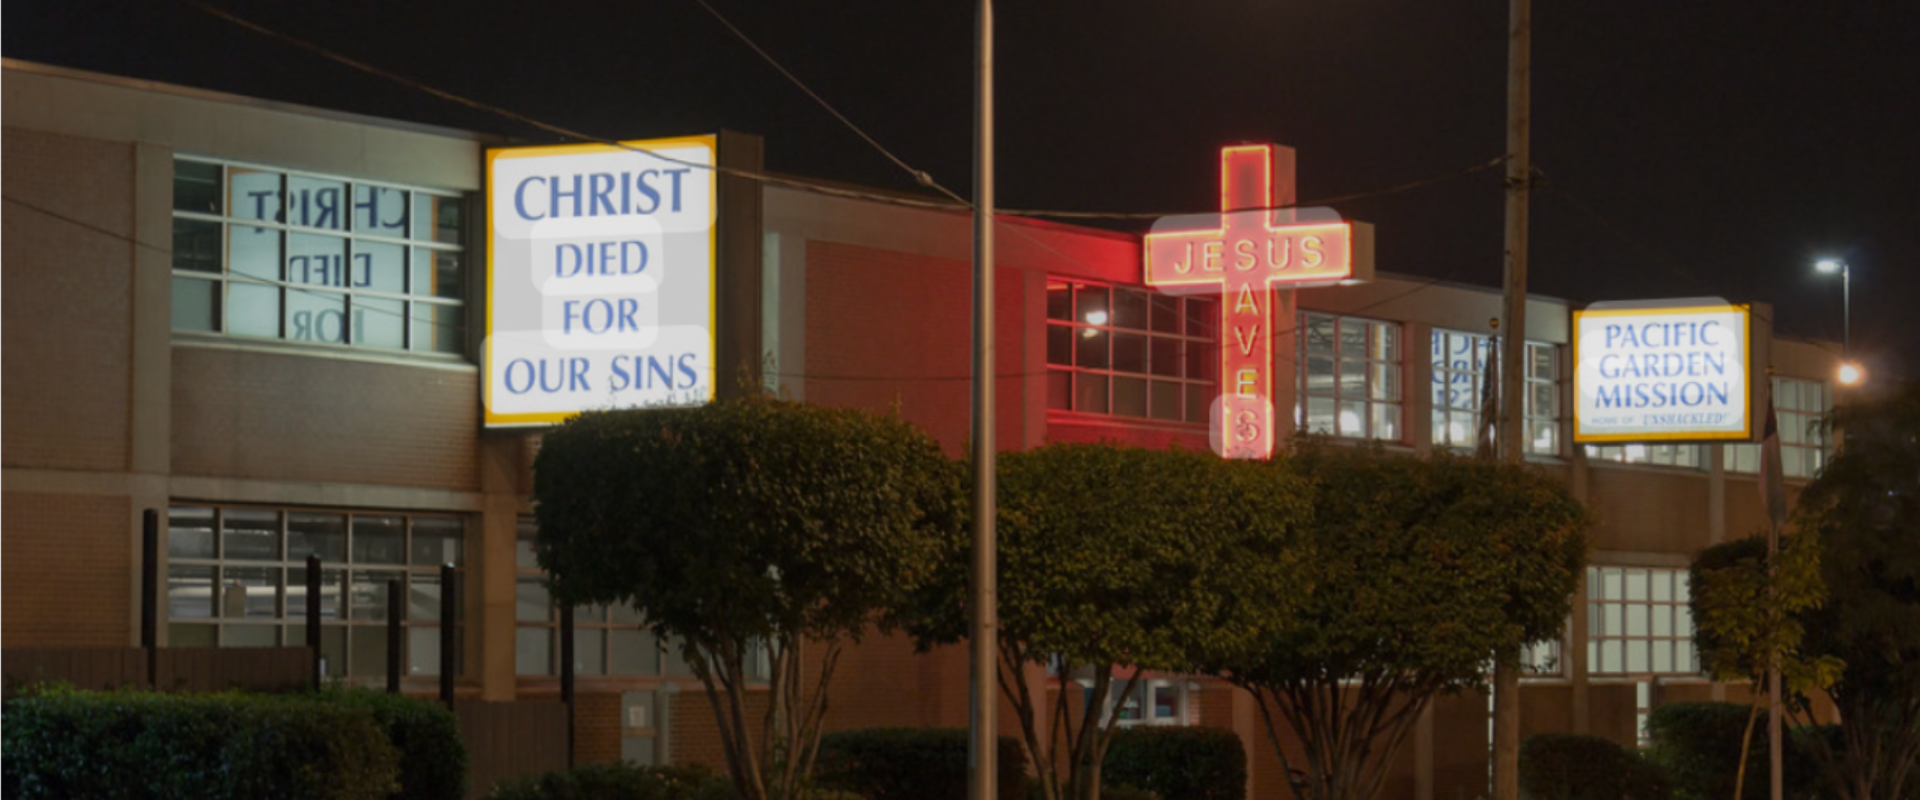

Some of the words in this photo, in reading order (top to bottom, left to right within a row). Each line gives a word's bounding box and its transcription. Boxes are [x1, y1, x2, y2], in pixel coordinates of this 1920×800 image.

[513, 167, 691, 221] CHRIST
[554, 239, 648, 278] DIED
[1174, 234, 1325, 275] JESUS
[562, 297, 640, 334] FOR
[1604, 320, 1721, 349] PACIFIC
[503, 356, 592, 394] OUR
[609, 352, 698, 391] SINS
[1599, 351, 1725, 380] GARDEN
[1595, 381, 1729, 409] MISSION
